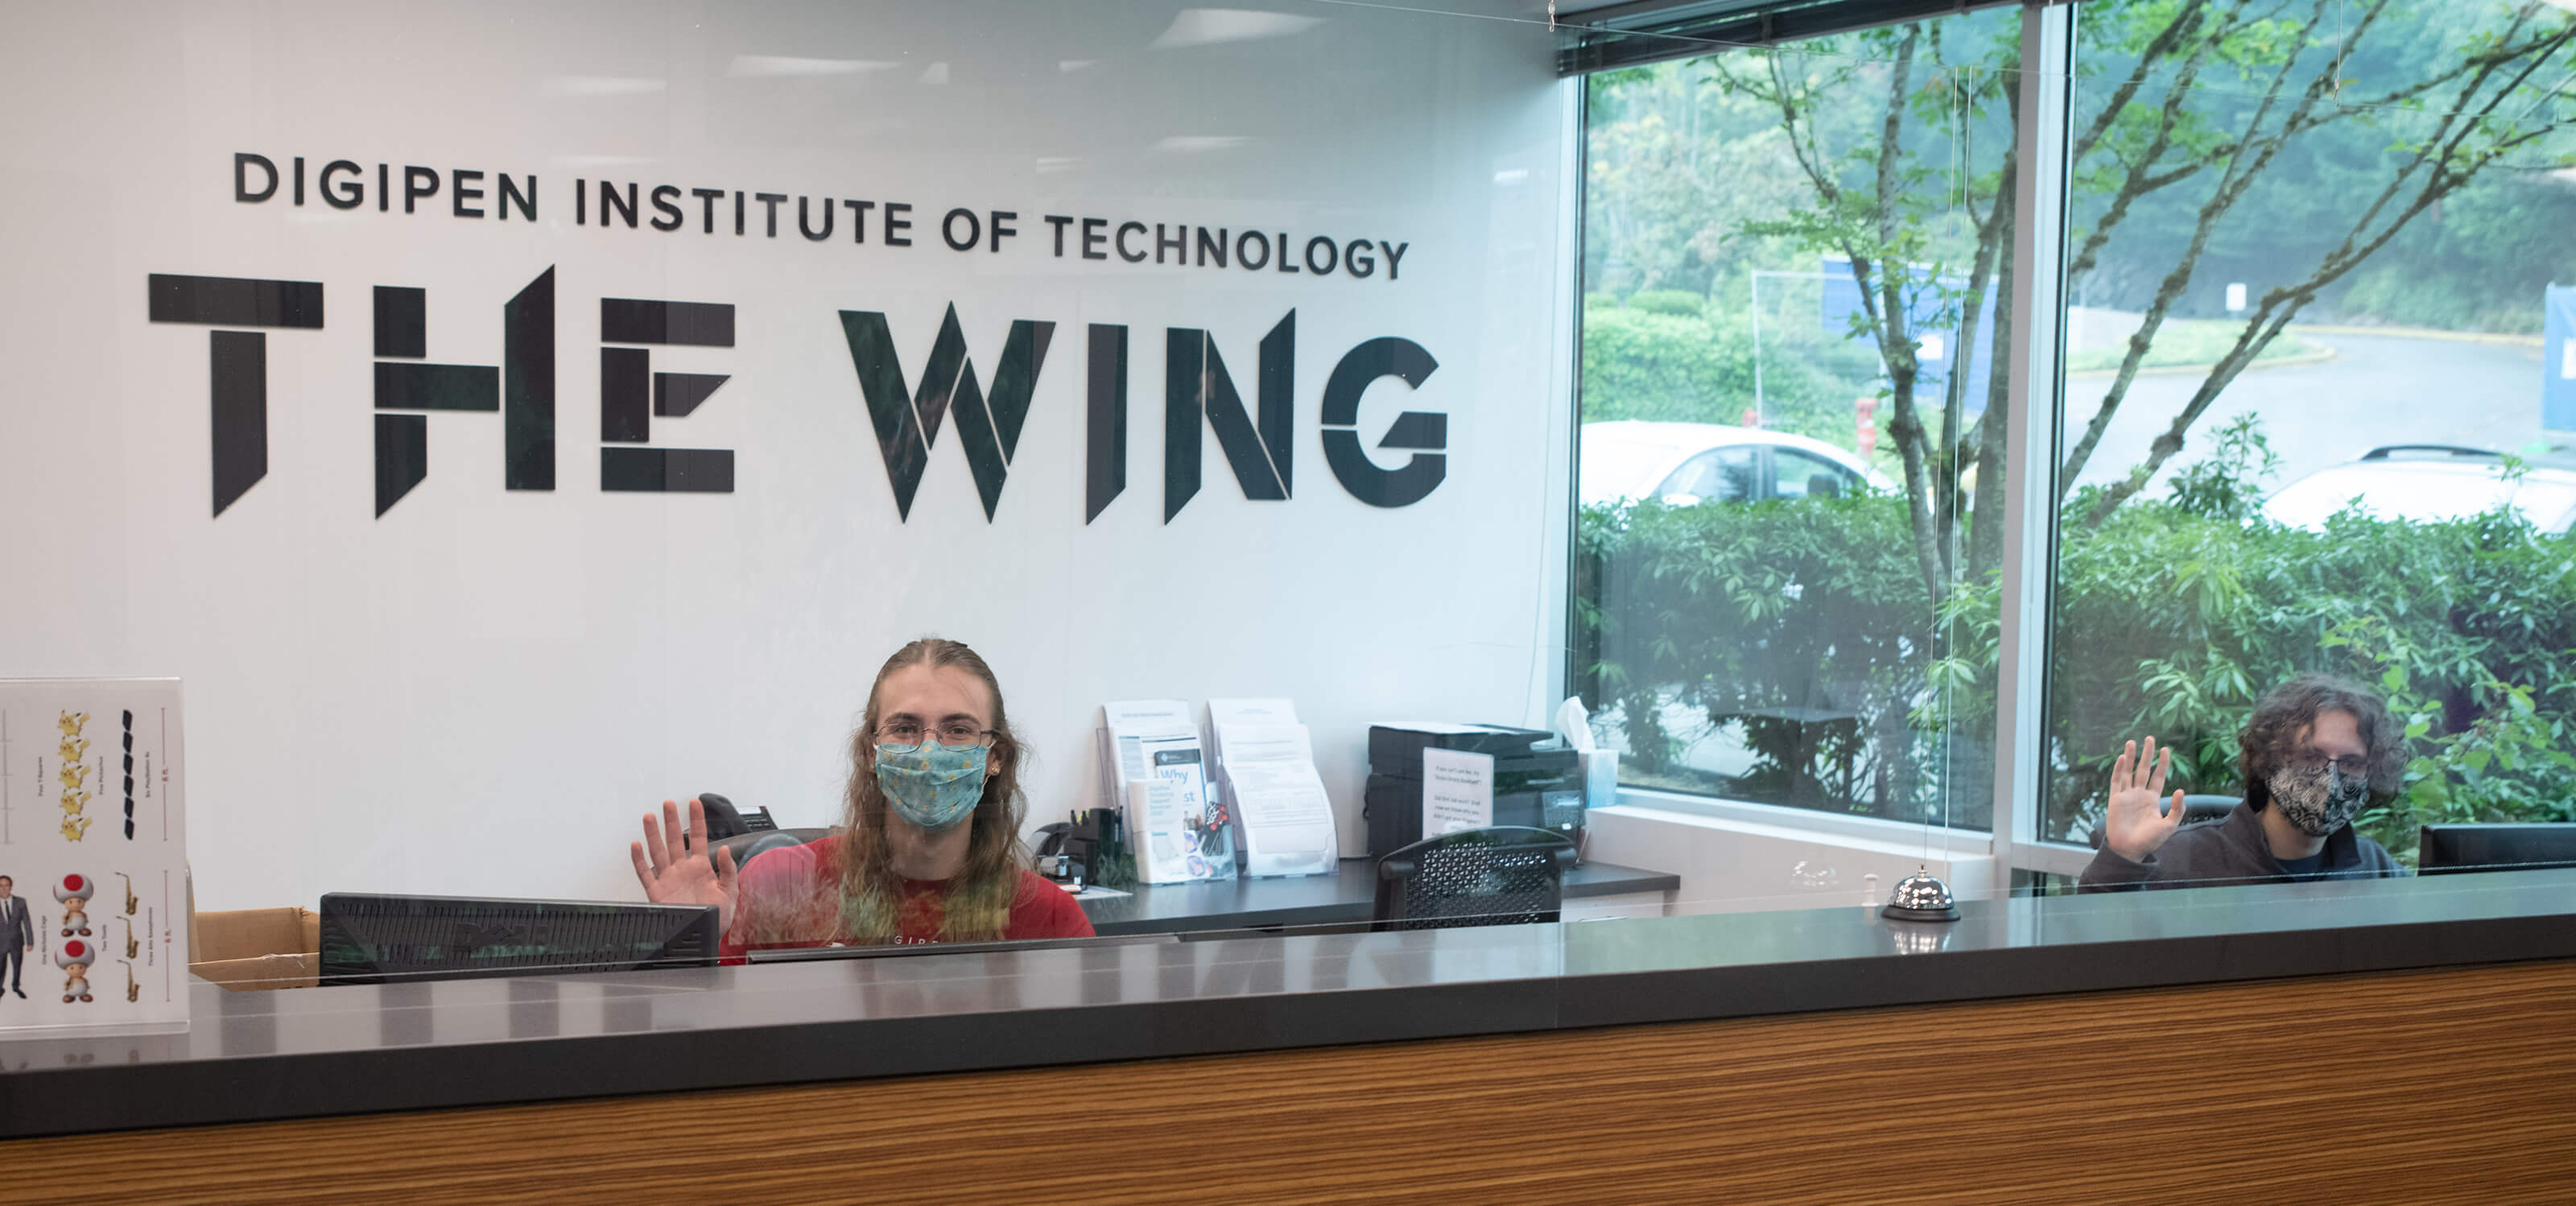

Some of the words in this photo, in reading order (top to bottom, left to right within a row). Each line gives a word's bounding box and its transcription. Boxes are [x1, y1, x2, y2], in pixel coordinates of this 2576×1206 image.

[235, 151, 538, 222] DIGIPEN
[576, 178, 912, 247] INSTITUTE
[942, 207, 1018, 253] OF
[1044, 214, 1410, 280] TECHNOLOGY
[148, 263, 736, 520] THE
[839, 300, 1448, 526] WING
[1160, 768, 1189, 785] Why
